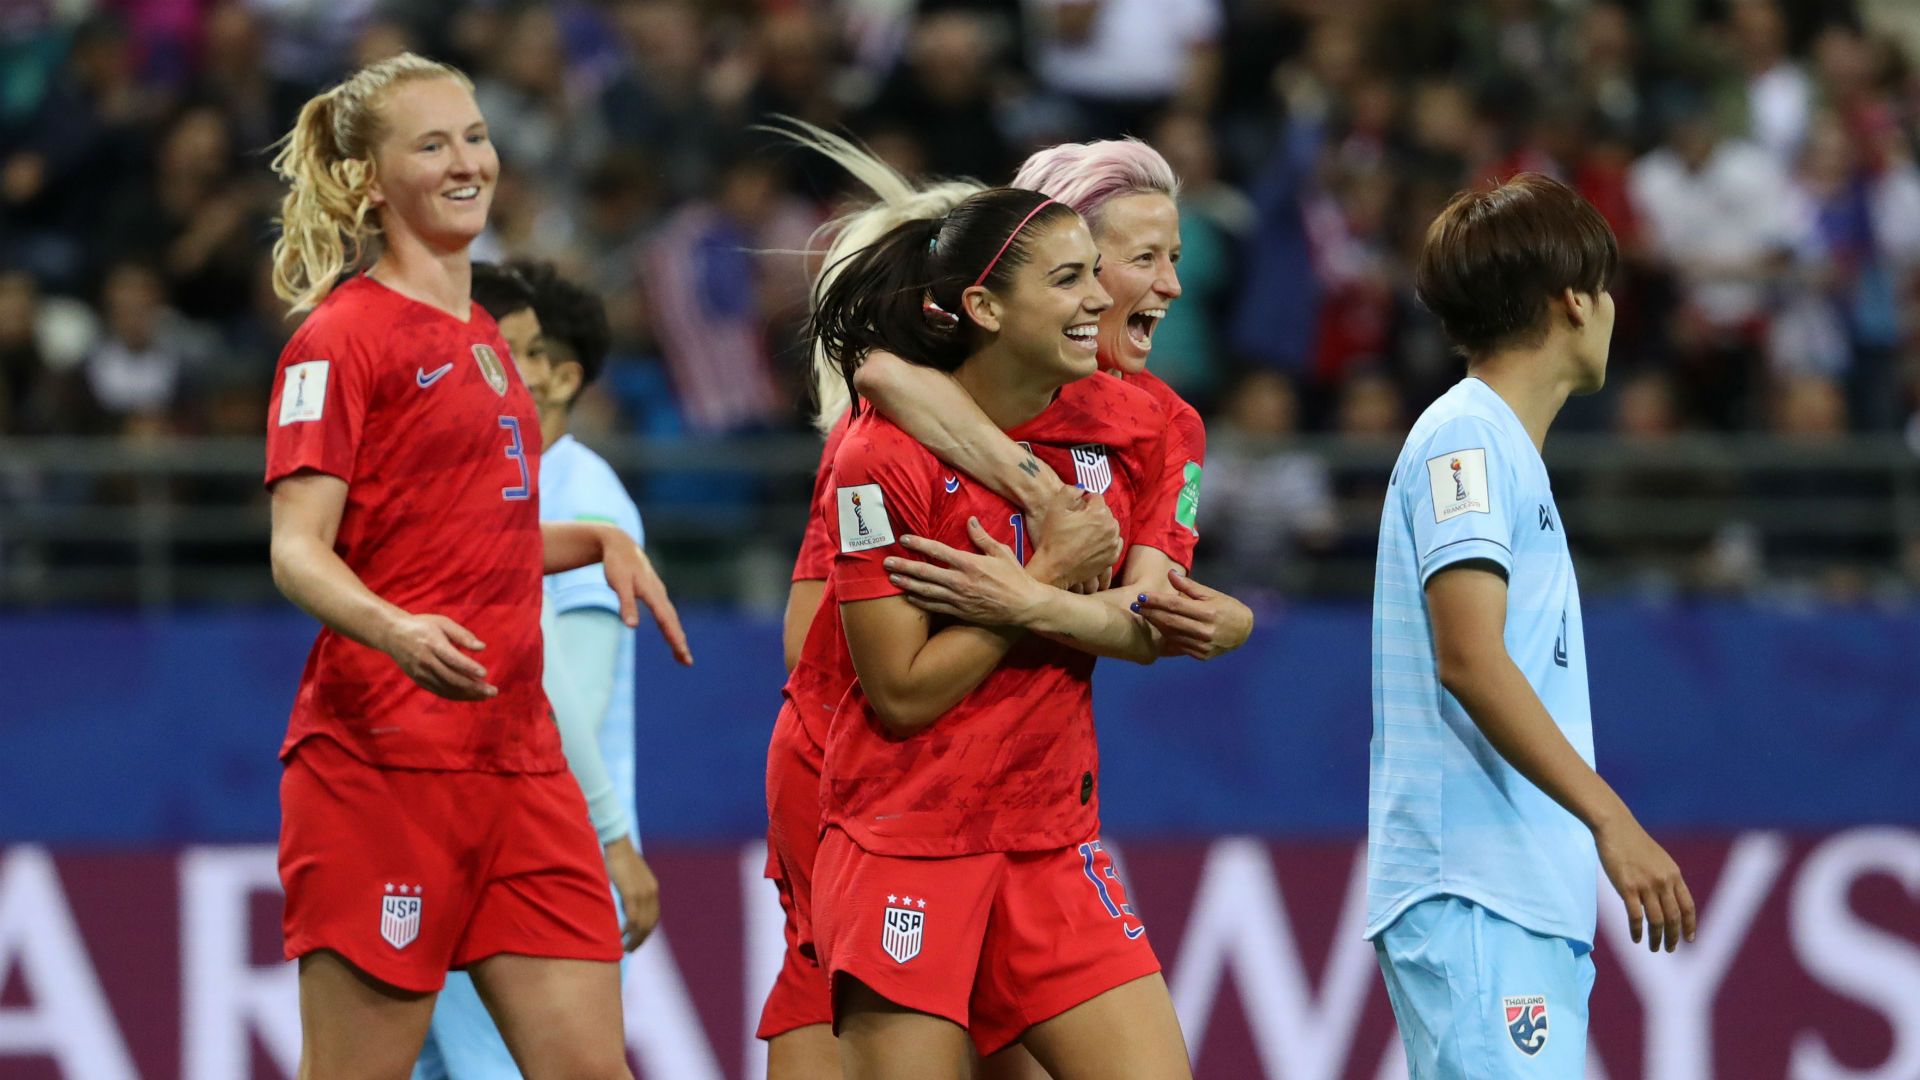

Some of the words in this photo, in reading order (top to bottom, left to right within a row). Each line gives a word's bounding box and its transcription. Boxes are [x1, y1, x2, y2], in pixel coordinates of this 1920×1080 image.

[499, 415, 530, 500] 3
[1074, 445, 1105, 466] USA
[1443, 502, 1467, 515] FRANCE
[848, 538, 872, 548] FRANCE
[872, 536, 886, 544] 2019
[386, 898, 418, 919] USA
[888, 910, 922, 933] USA
[1504, 996, 1544, 1006] THAILAND
